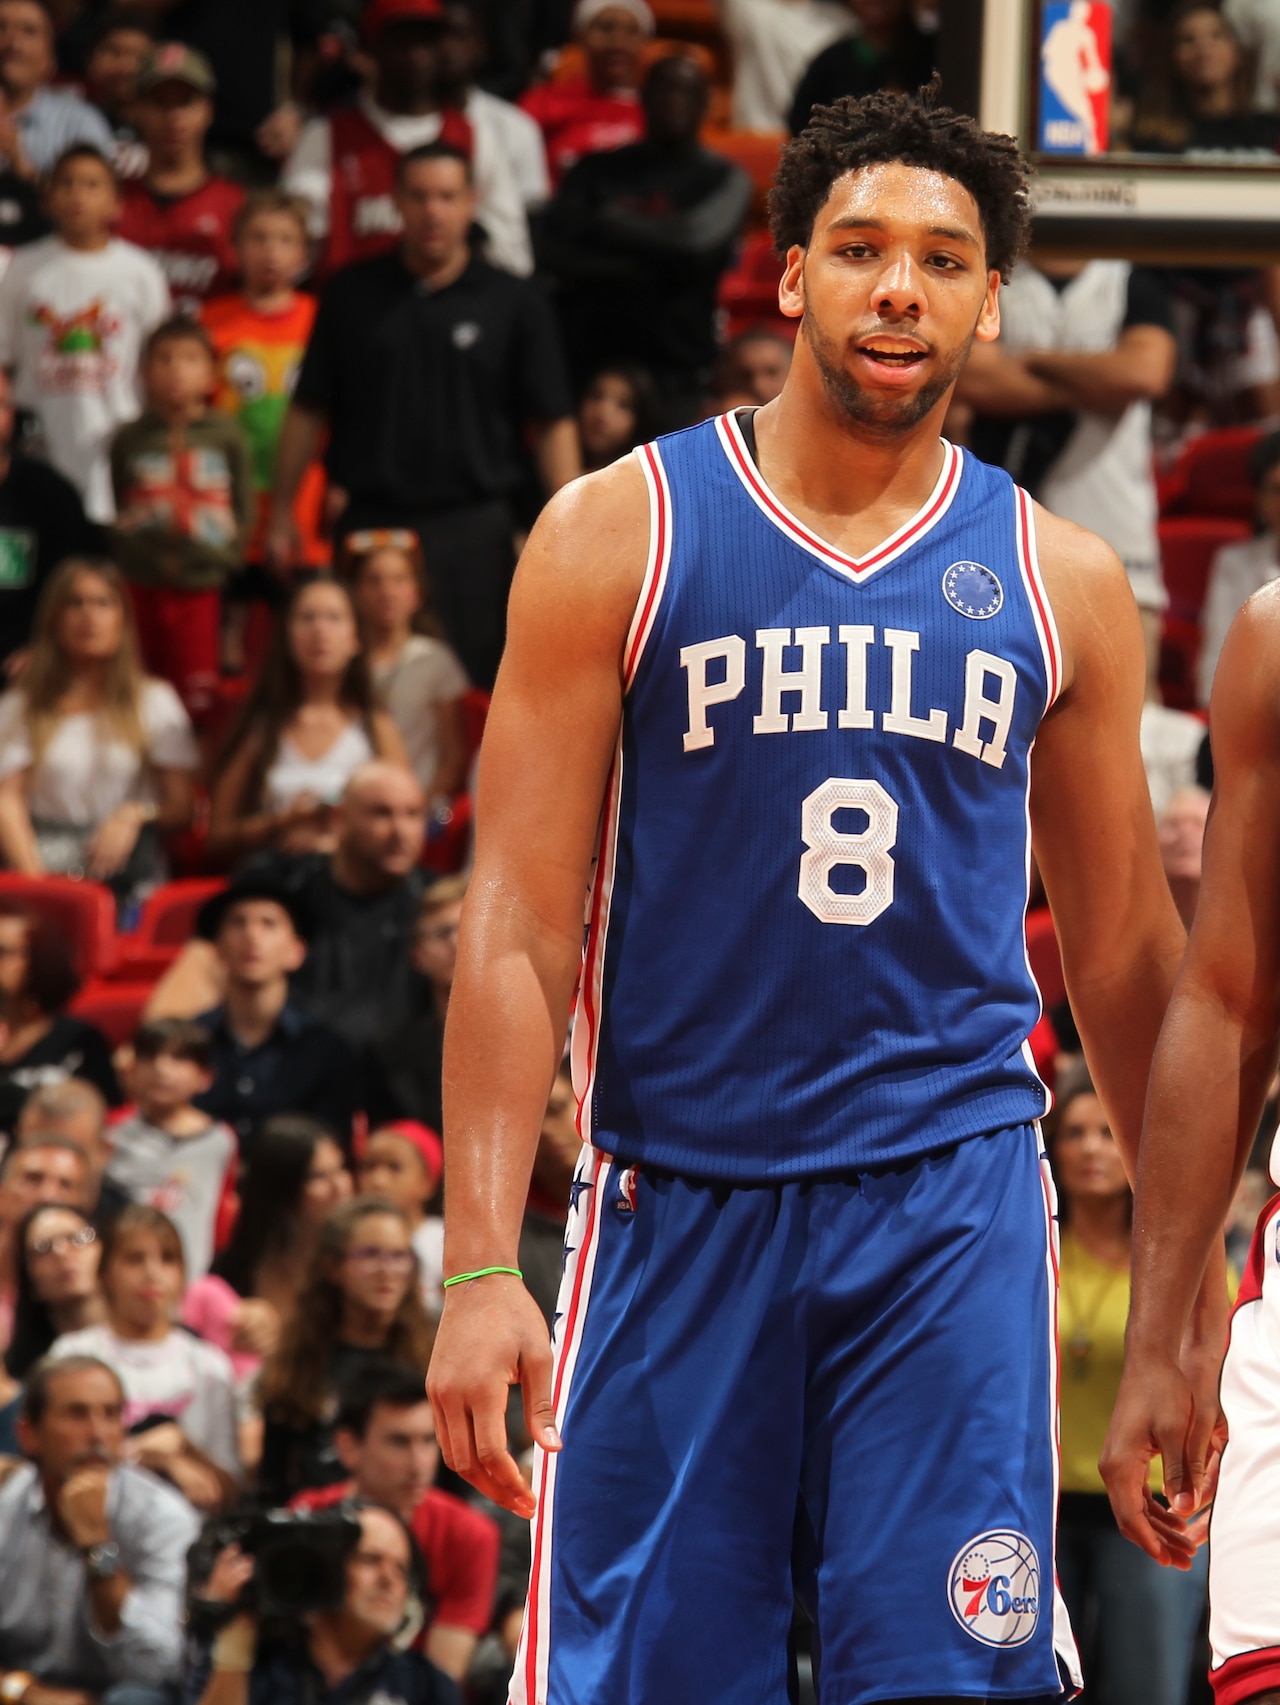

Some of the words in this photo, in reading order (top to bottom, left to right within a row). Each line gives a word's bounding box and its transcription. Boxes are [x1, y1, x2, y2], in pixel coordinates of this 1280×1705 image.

[679, 624, 1017, 769] PHILA
[797, 777, 899, 926] 8
[962, 1575, 1038, 1618] 76ers
